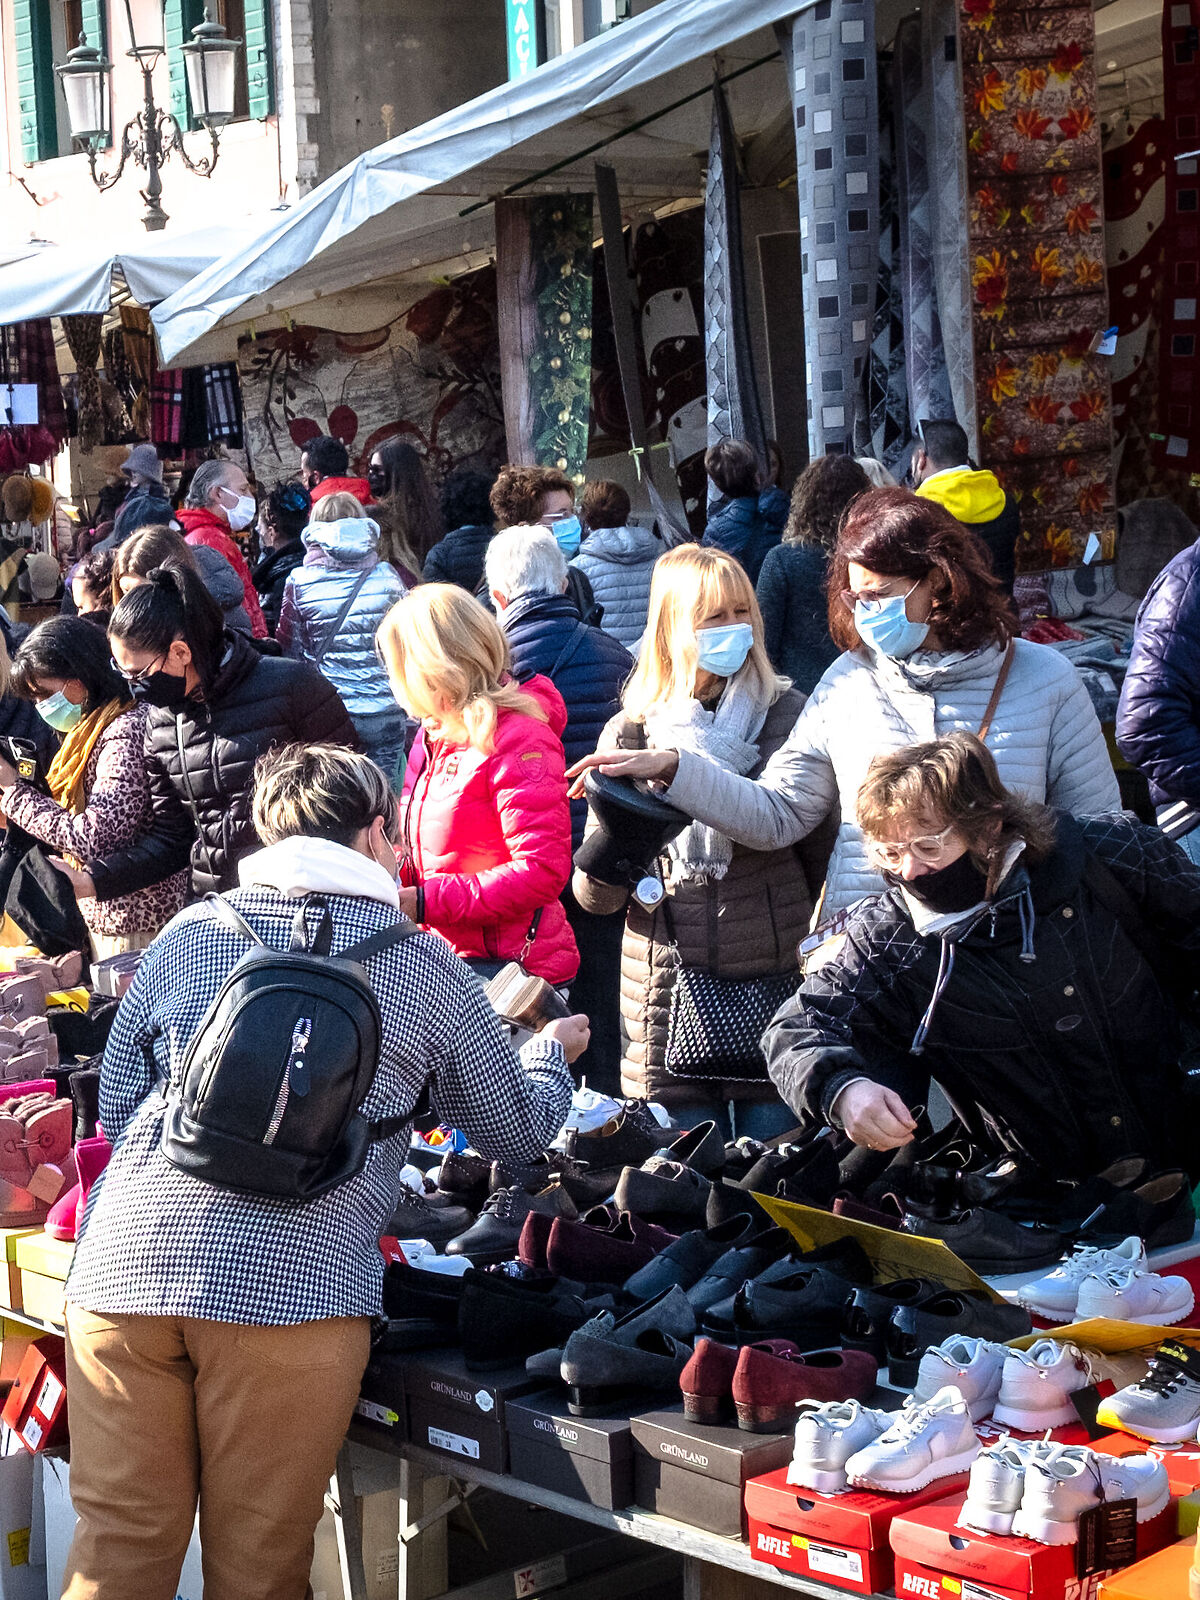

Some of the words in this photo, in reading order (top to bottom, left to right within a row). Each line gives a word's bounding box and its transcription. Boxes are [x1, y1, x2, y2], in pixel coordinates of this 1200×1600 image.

[511, 0, 530, 75] ACI
[430, 1381, 472, 1402] GRÜNLAND
[533, 1419, 579, 1441] GRÜNLAND
[660, 1442, 709, 1467] GRÜNLAND
